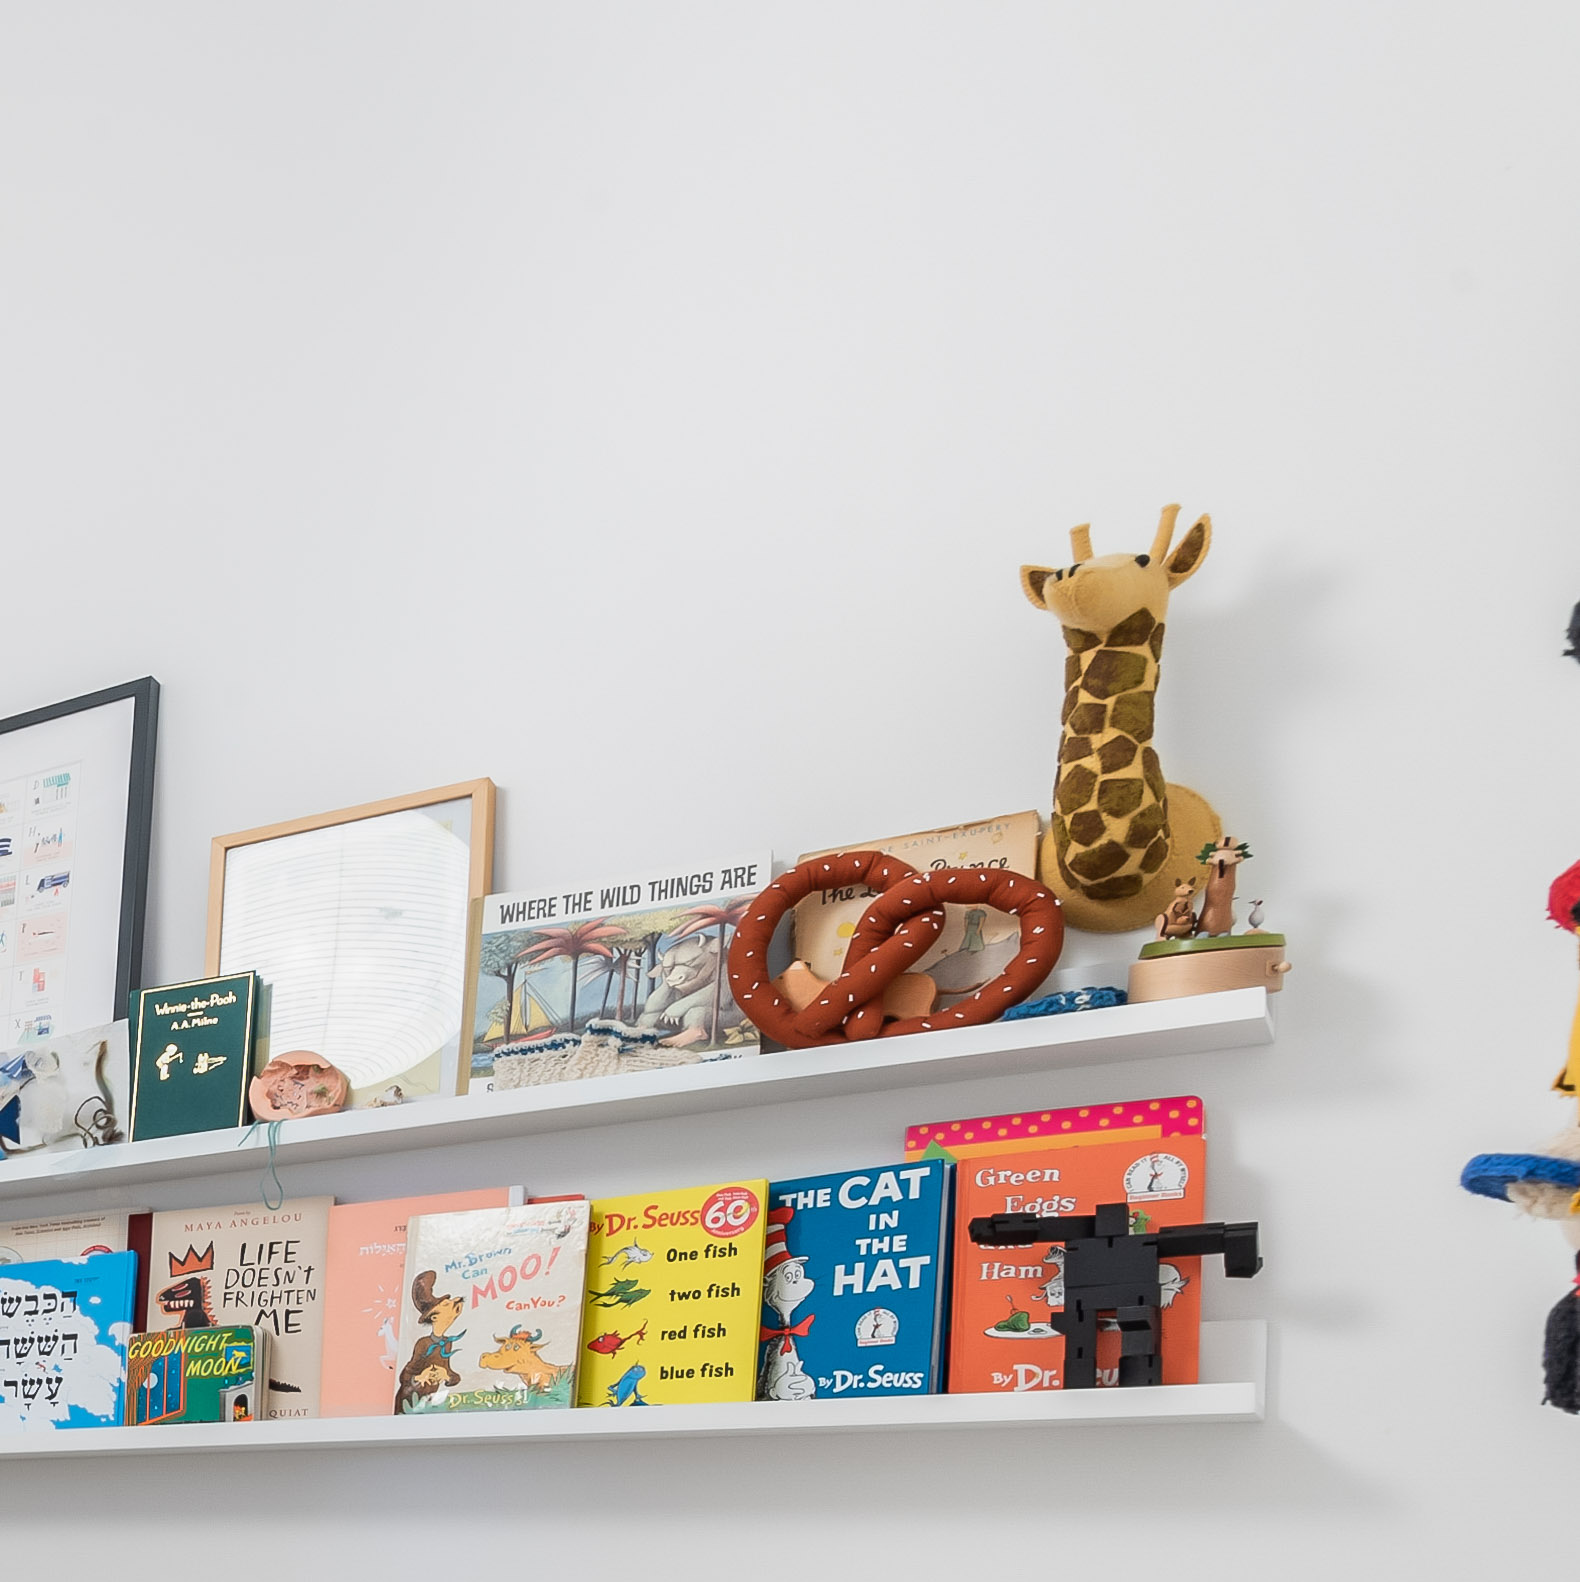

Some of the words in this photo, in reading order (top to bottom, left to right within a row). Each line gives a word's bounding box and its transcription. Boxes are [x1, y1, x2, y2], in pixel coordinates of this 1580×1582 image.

[499, 896, 558, 925] WHERE
[562, 890, 594, 917] THE
[599, 884, 642, 910] WILD
[648, 871, 714, 902] THINGS
[720, 864, 758, 892] ARE
[154, 991, 238, 1017] Winnie-the-Pooh
[191, 1016, 219, 1028] Milne
[779, 1188, 832, 1210] THE
[837, 1167, 932, 1210] CAT
[975, 1167, 1060, 1189] Green
[705, 1200, 751, 1229] 60
[1004, 1194, 1077, 1218] Eggs
[184, 1221, 222, 1232] MAYA
[230, 1213, 302, 1228] ANGELOU
[590, 1221, 604, 1235] By
[605, 1213, 639, 1237] Dr.
[642, 1205, 701, 1230] Seuss
[868, 1210, 899, 1231] IN
[239, 1240, 301, 1266] LIFE
[666, 1248, 699, 1263] One
[704, 1242, 739, 1260] fish
[855, 1234, 908, 1256] THE
[444, 1261, 466, 1274] Mr.
[467, 1247, 513, 1267] Brown
[979, 1261, 1044, 1282] Ham
[461, 1267, 488, 1280] Can
[471, 1246, 562, 1310] MOO!
[833, 1255, 931, 1297] HAT
[223, 1288, 317, 1308] FRIGHTEN
[530, 1294, 567, 1311] You?
[669, 1287, 702, 1302] two
[706, 1282, 741, 1299] fish
[254, 1308, 304, 1336] ME
[660, 1325, 687, 1341] red
[692, 1323, 727, 1339] fish
[128, 1333, 233, 1359] GOODNIGHT
[186, 1356, 243, 1377] MOON
[659, 1365, 695, 1380] blue
[700, 1362, 735, 1379] fish
[817, 1376, 833, 1389] By
[833, 1370, 865, 1393] Dr.
[866, 1365, 924, 1390] Seuss
[991, 1371, 1013, 1386] By
[1012, 1364, 1060, 1392] Dr.
[449, 1392, 471, 1408] Dr.
[269, 1408, 309, 1418] QUIAT
